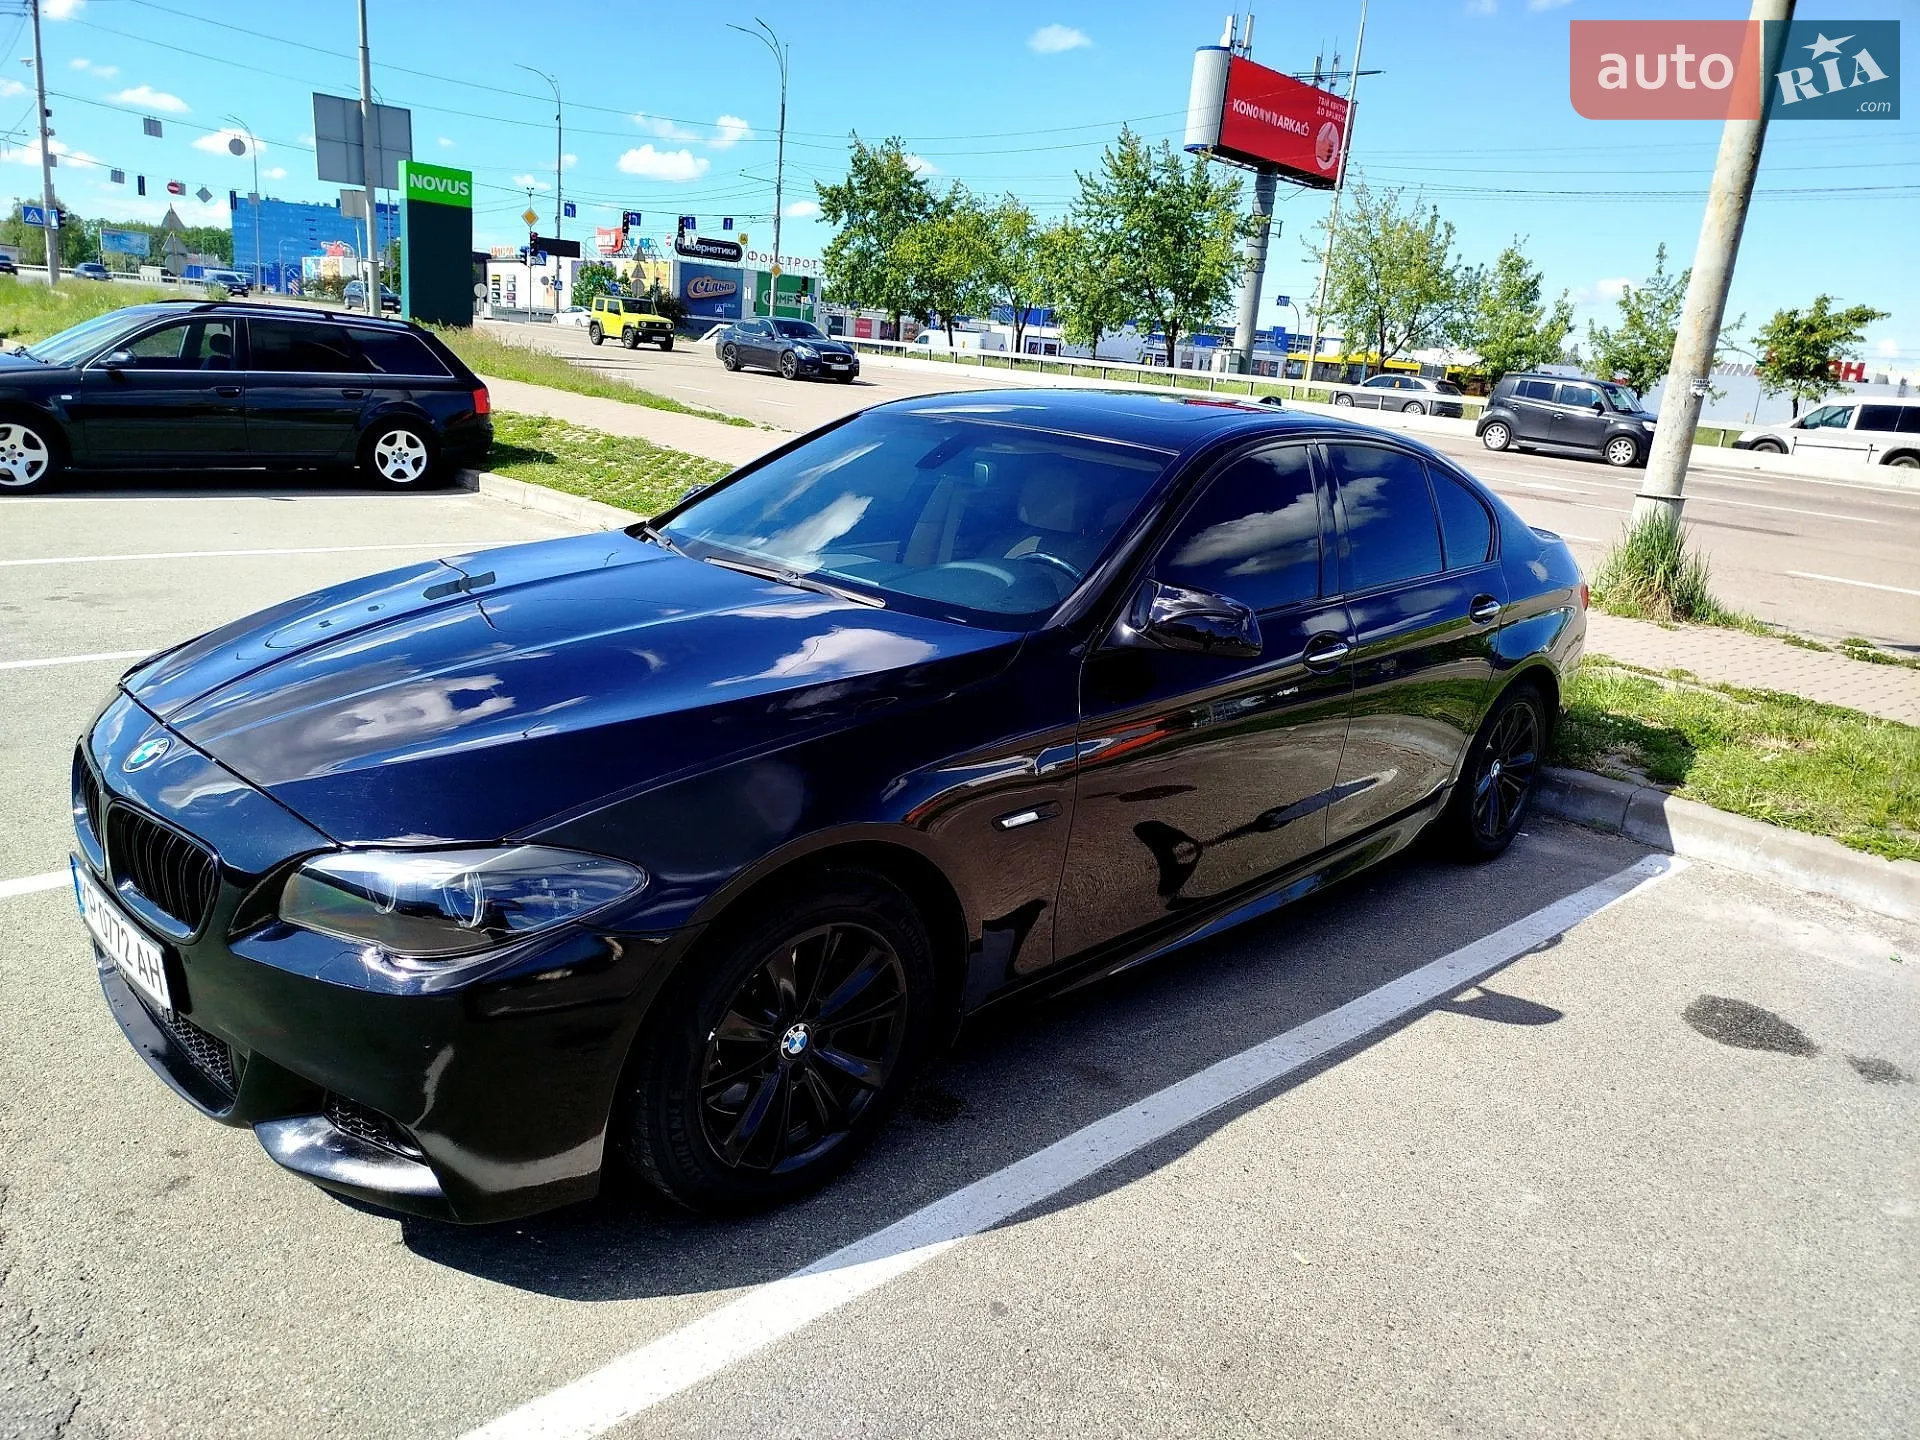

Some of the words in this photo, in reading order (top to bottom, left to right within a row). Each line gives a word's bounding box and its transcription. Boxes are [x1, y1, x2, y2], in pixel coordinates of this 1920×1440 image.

[409, 173, 470, 197] NOVUS
[98, 901, 134, 967] 0772
[137, 942, 164, 996] AH
